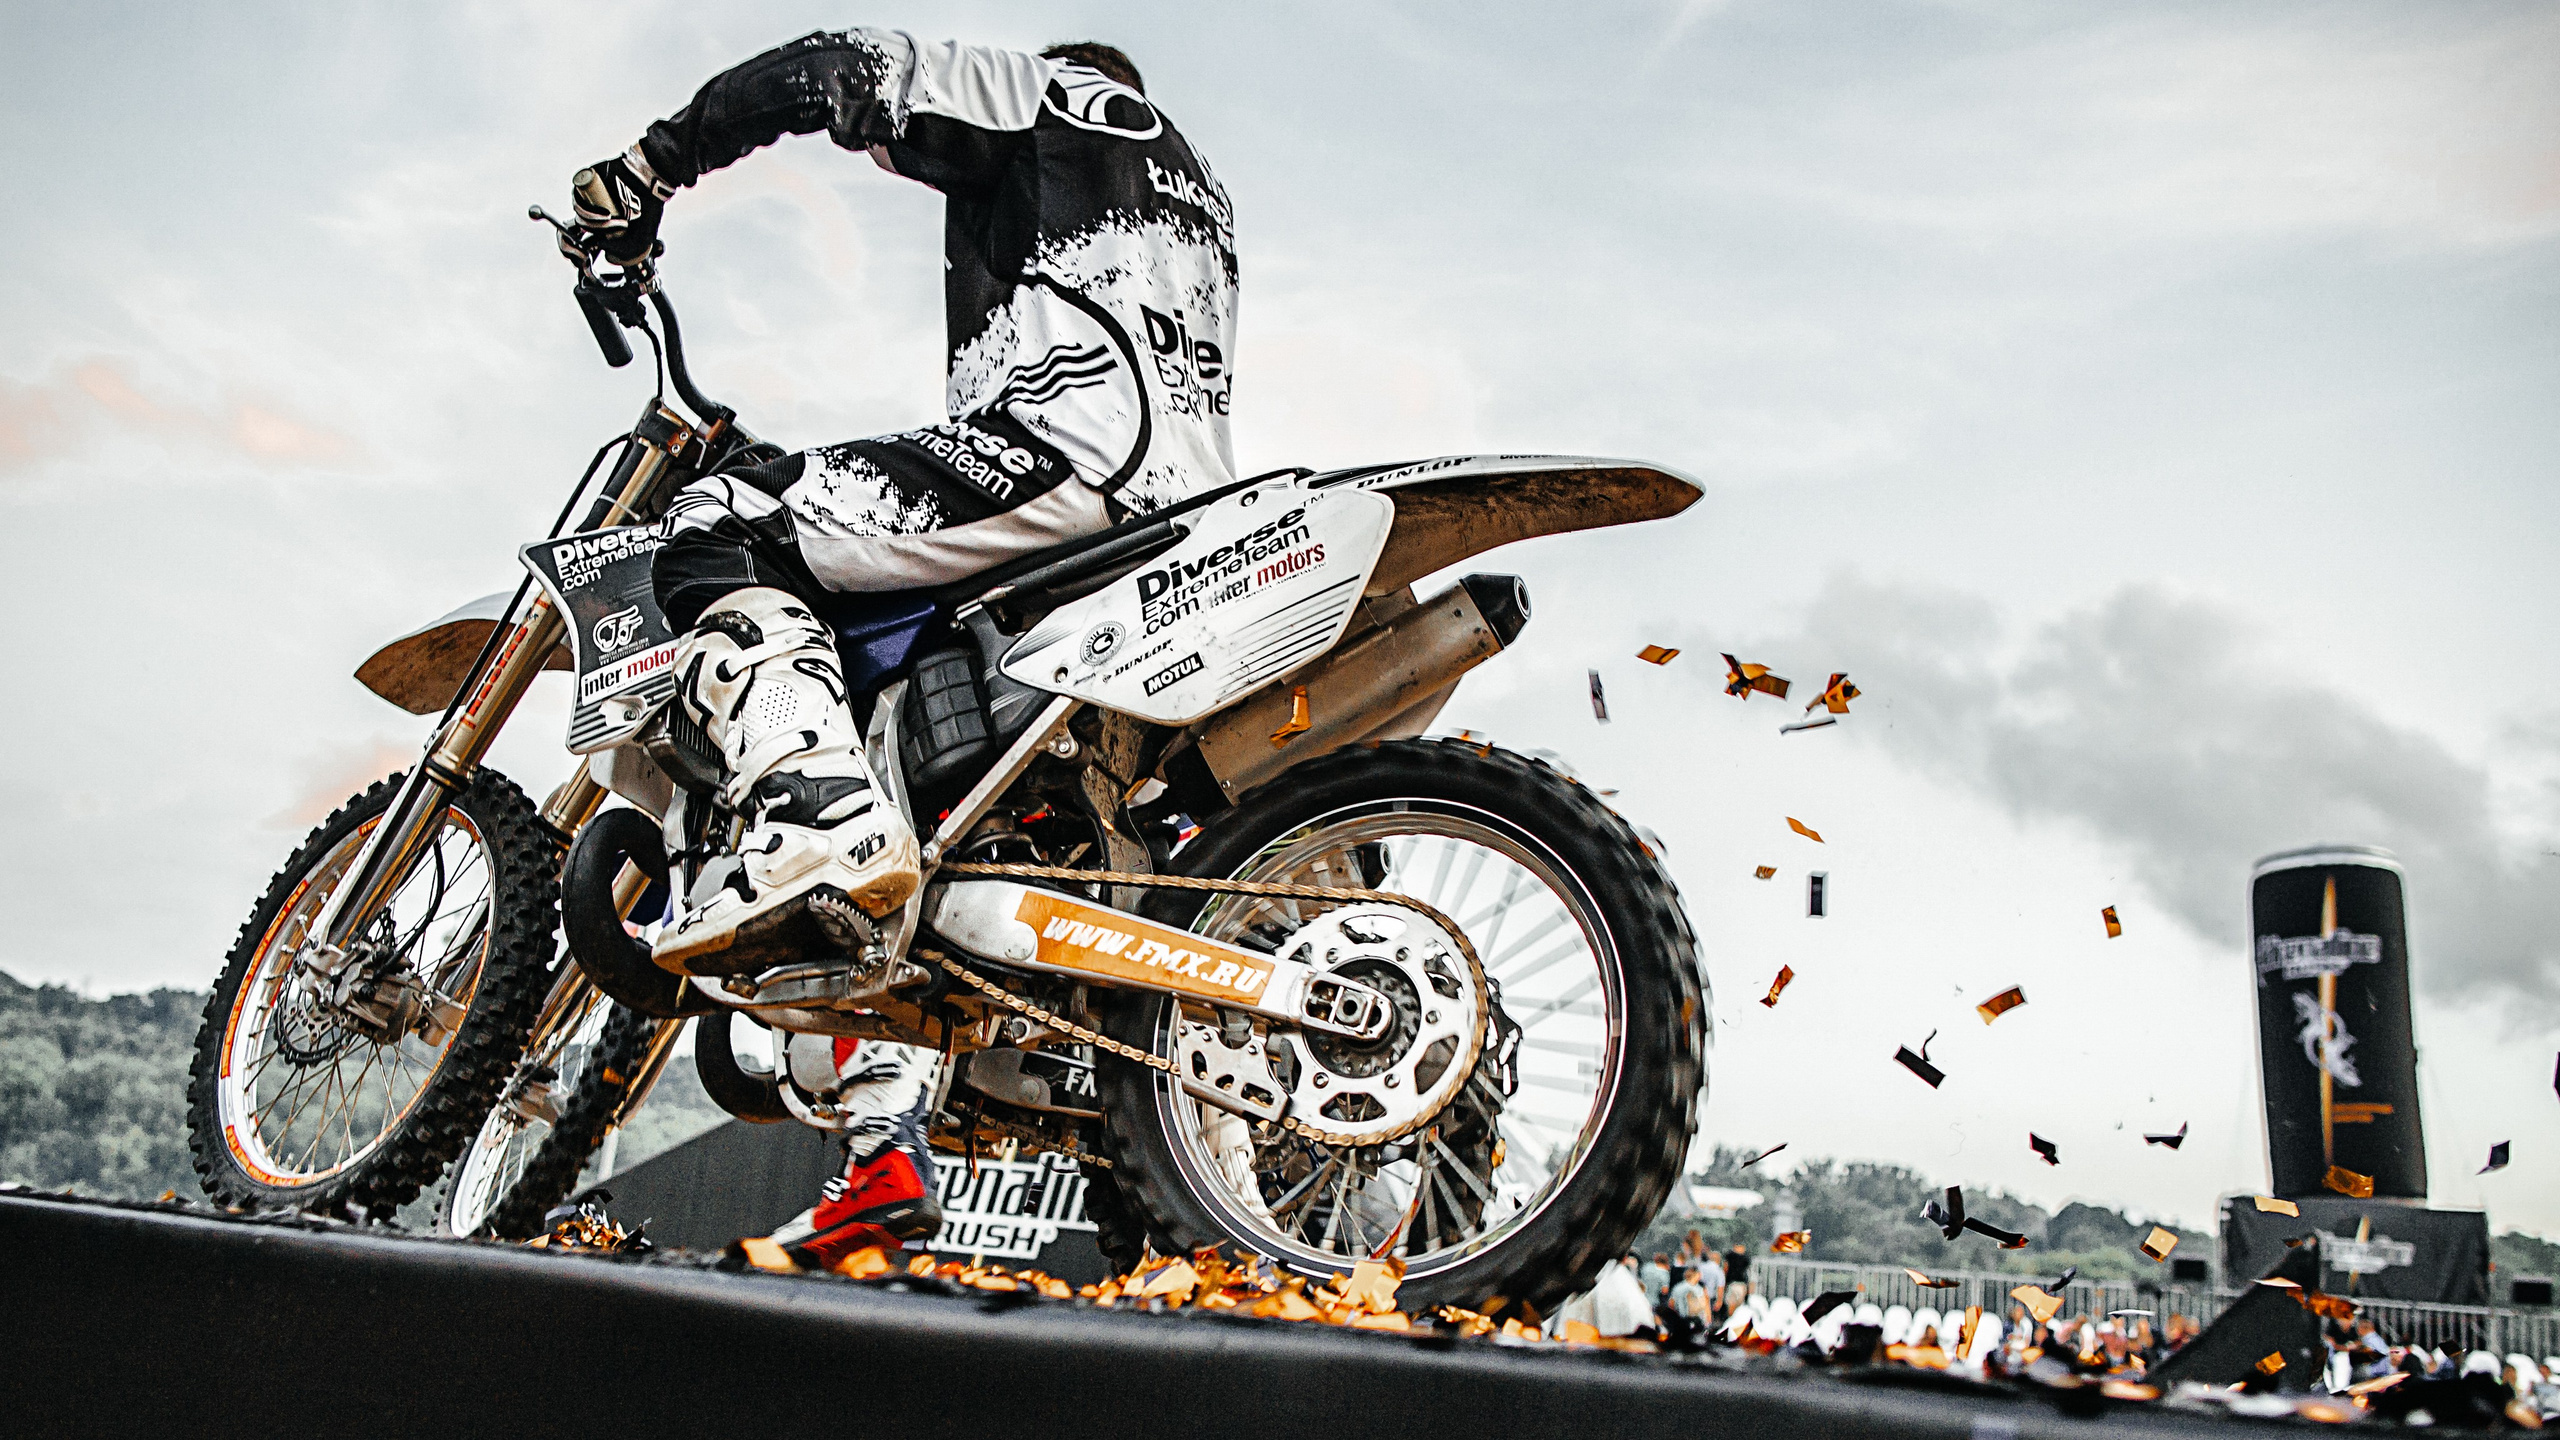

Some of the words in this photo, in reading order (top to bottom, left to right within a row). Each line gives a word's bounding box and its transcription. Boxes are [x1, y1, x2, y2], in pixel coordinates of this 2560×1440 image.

[1136, 508, 1306, 605] Diverse
[1141, 524, 1310, 622] ExtremeTeam
[1256, 543, 1326, 587] motors
[561, 568, 602, 592] .com
[1141, 597, 1200, 639] .com
[584, 667, 623, 697] inter
[626, 646, 678, 679] motor
[1114, 638, 1175, 677] DUNLOP
[1147, 656, 1201, 694] MOTUL
[1041, 915, 1269, 993] WWW.FMX.RU
